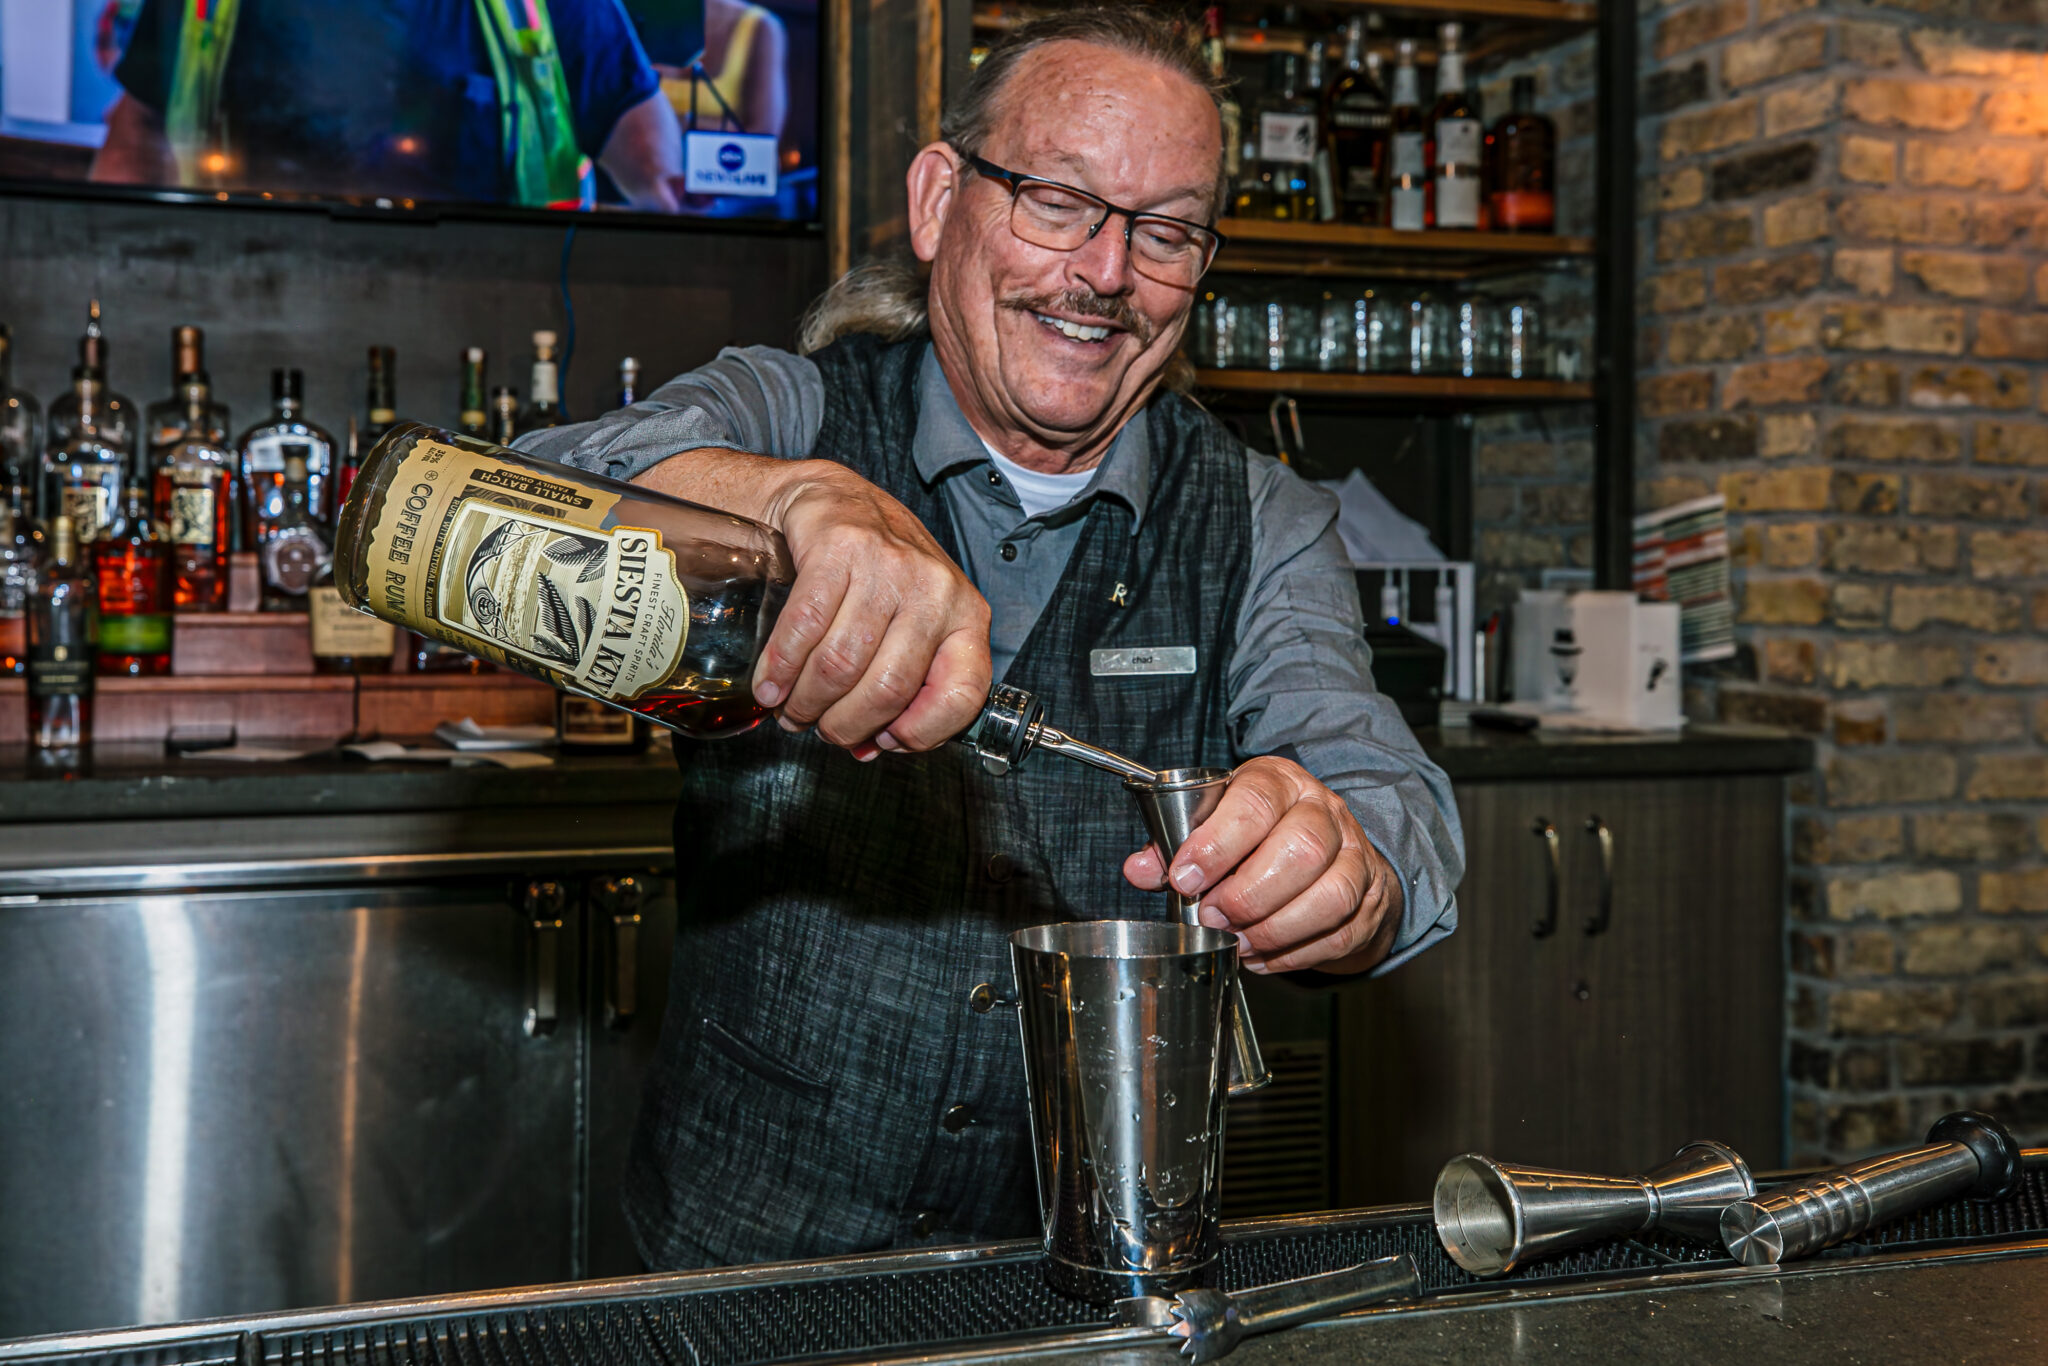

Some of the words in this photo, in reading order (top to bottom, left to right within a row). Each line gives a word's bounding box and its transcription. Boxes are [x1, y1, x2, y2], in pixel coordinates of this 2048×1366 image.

[429, 449, 446, 464] 35%
[480, 472, 528, 491] BATCH
[501, 471, 534, 484] OWNED
[534, 481, 570, 493] FAMILY
[446, 499, 460, 518] RUM
[533, 486, 583, 506] SMALL
[388, 483, 433, 565] COFFEE
[440, 519, 452, 544] WITH
[427, 545, 442, 584] NATURAL
[386, 569, 407, 614] RUM
[601, 537, 648, 641] SIESTA
[648, 572, 662, 612] FINEST
[637, 613, 654, 646] CRAFT
[648, 600, 676, 672] Florida's
[583, 643, 627, 695] KEY
[625, 649, 644, 683] SPIRITS
[1132, 656, 1153, 665] chad
